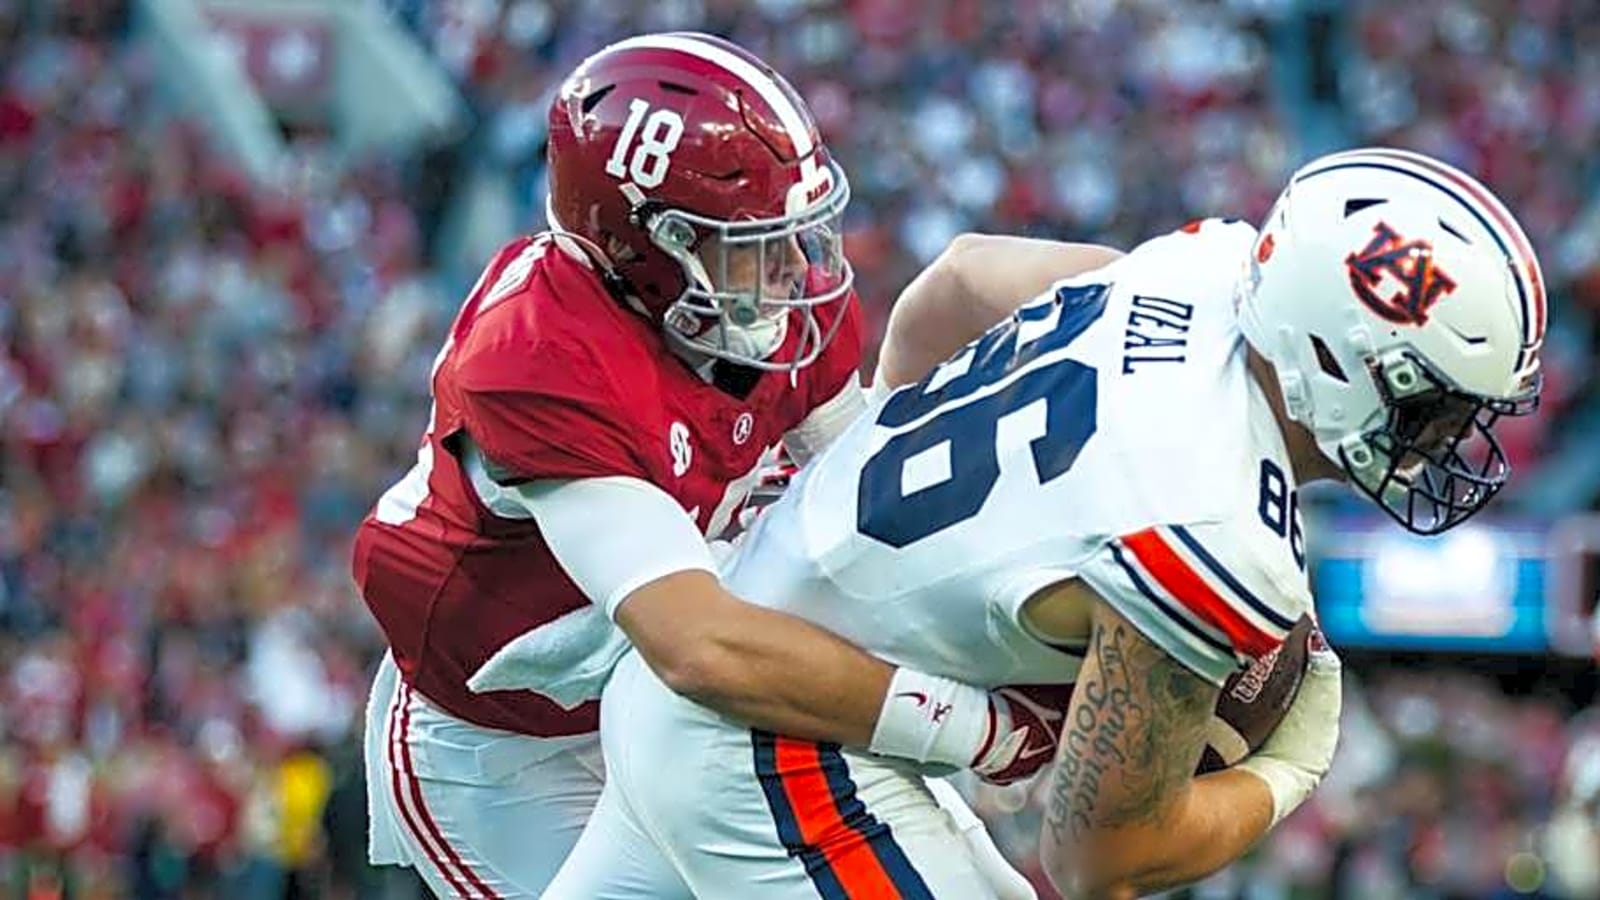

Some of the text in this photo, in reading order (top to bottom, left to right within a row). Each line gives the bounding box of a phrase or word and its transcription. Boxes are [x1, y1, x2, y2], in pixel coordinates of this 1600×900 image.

[605, 98, 685, 189] 18
[1122, 294, 1194, 375] DEAL
[857, 282, 1115, 549] 86
[1047, 680, 1108, 845] JOURNEY
